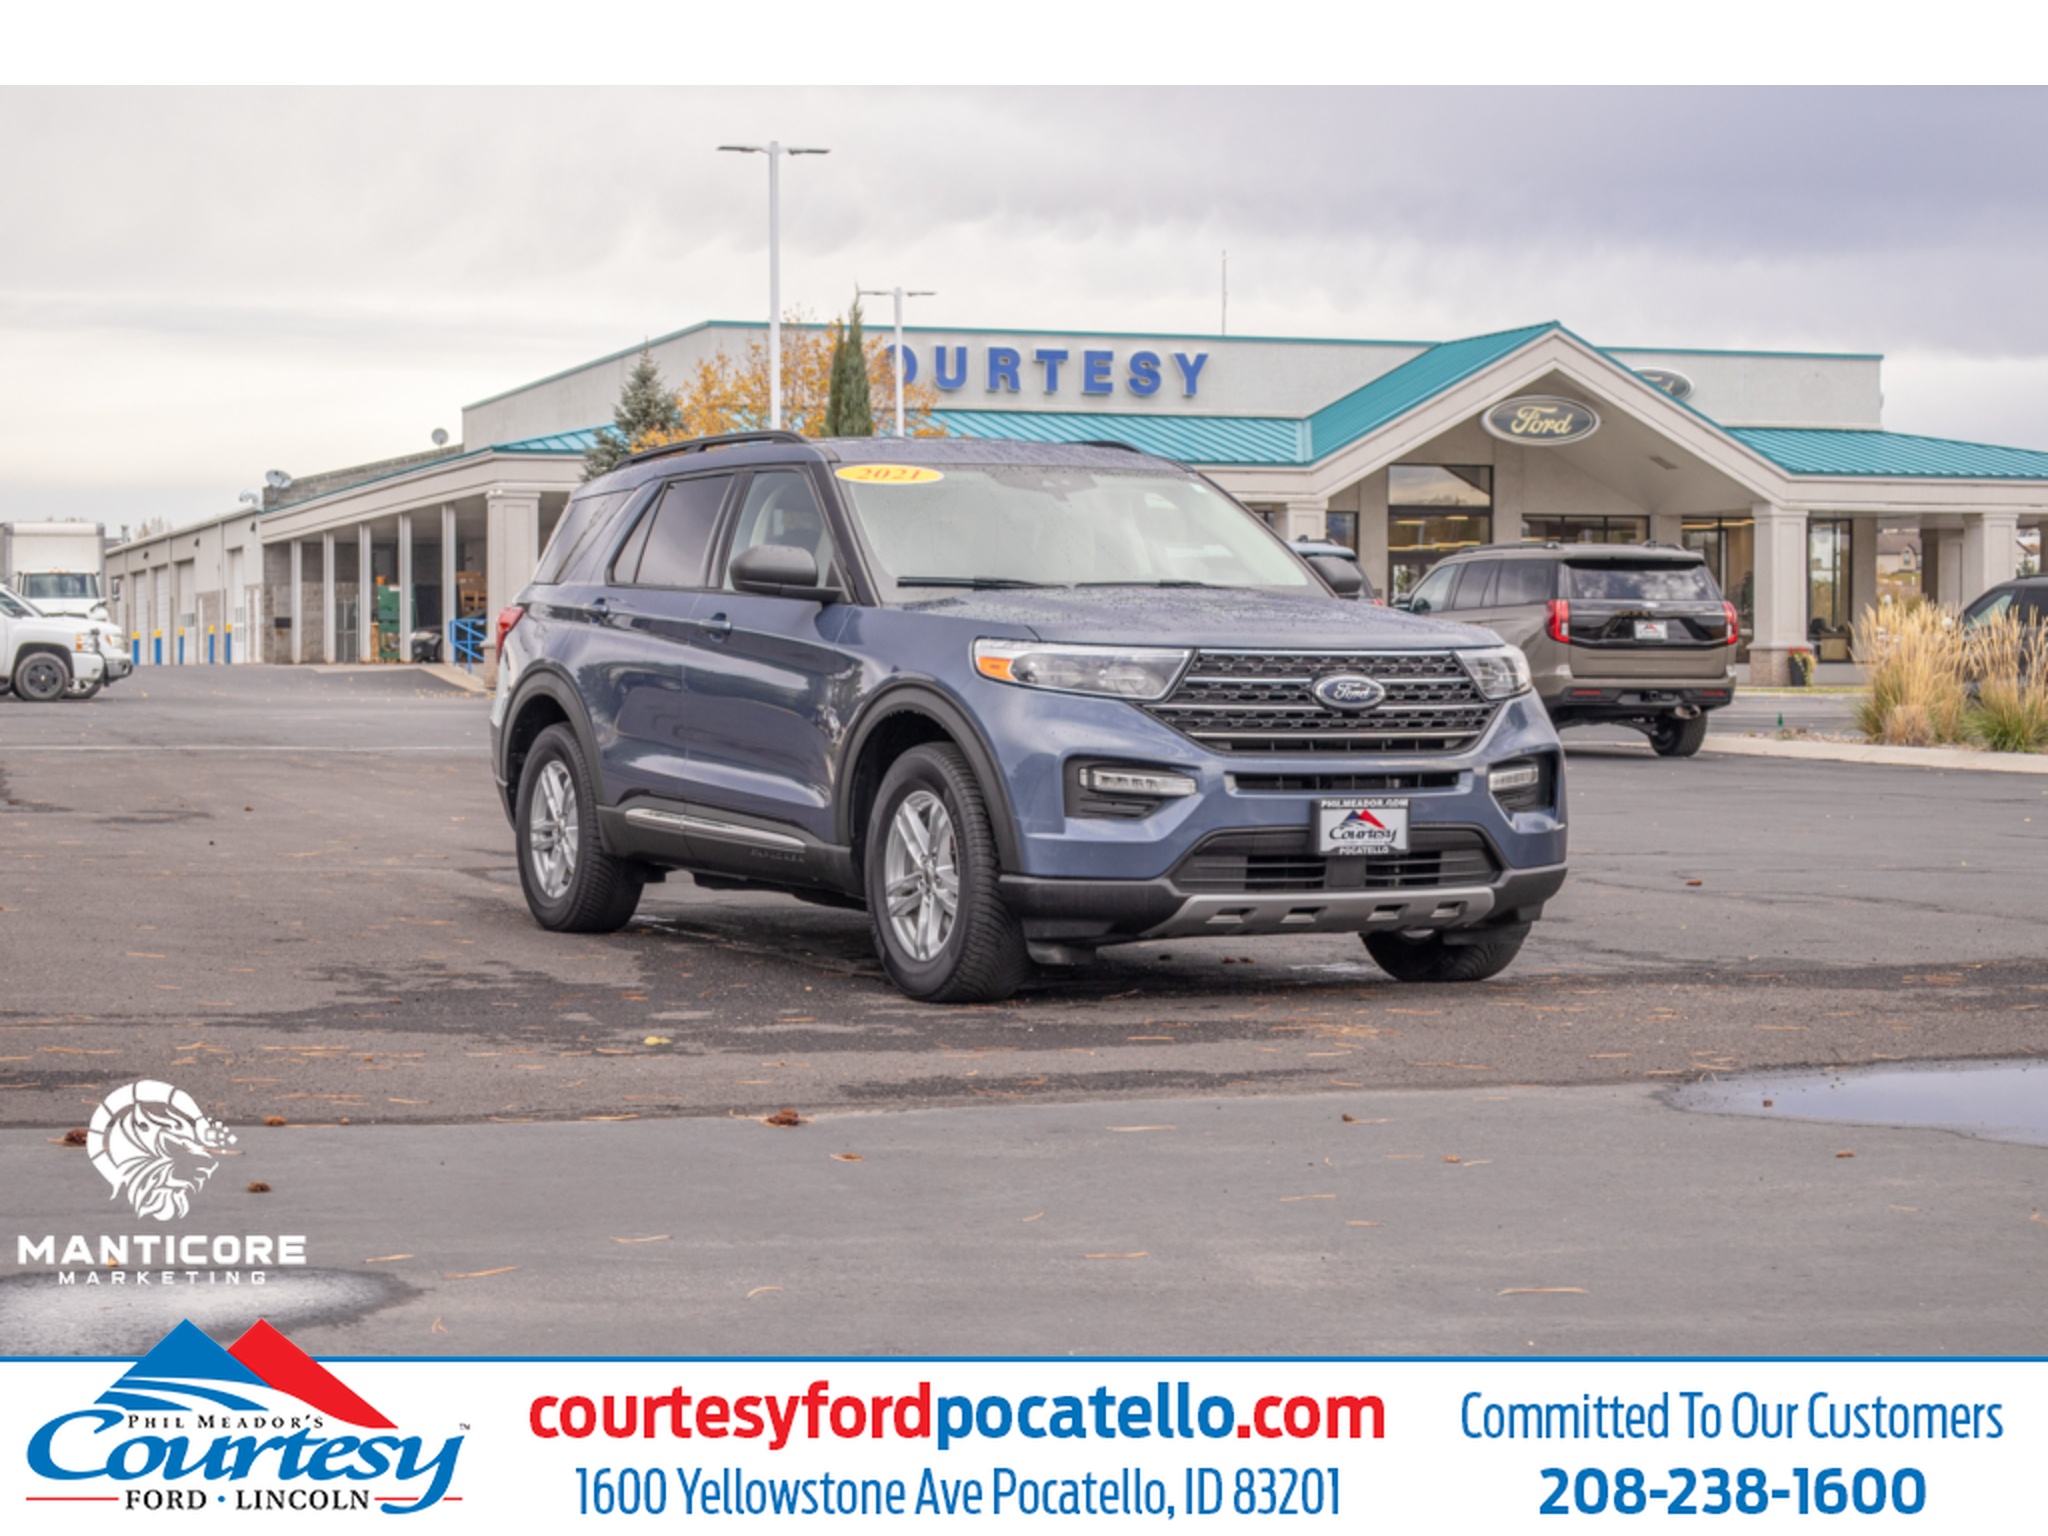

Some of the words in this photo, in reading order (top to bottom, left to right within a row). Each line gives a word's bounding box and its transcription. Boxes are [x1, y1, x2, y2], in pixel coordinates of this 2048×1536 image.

[878, 343, 1210, 396] OURTESY
[1510, 405, 1573, 434] Ford
[857, 468, 920, 480] 2021
[1334, 682, 1371, 699] Ford
[1329, 827, 1398, 843] Courtesy
[1339, 846, 1389, 855] POCATELLO
